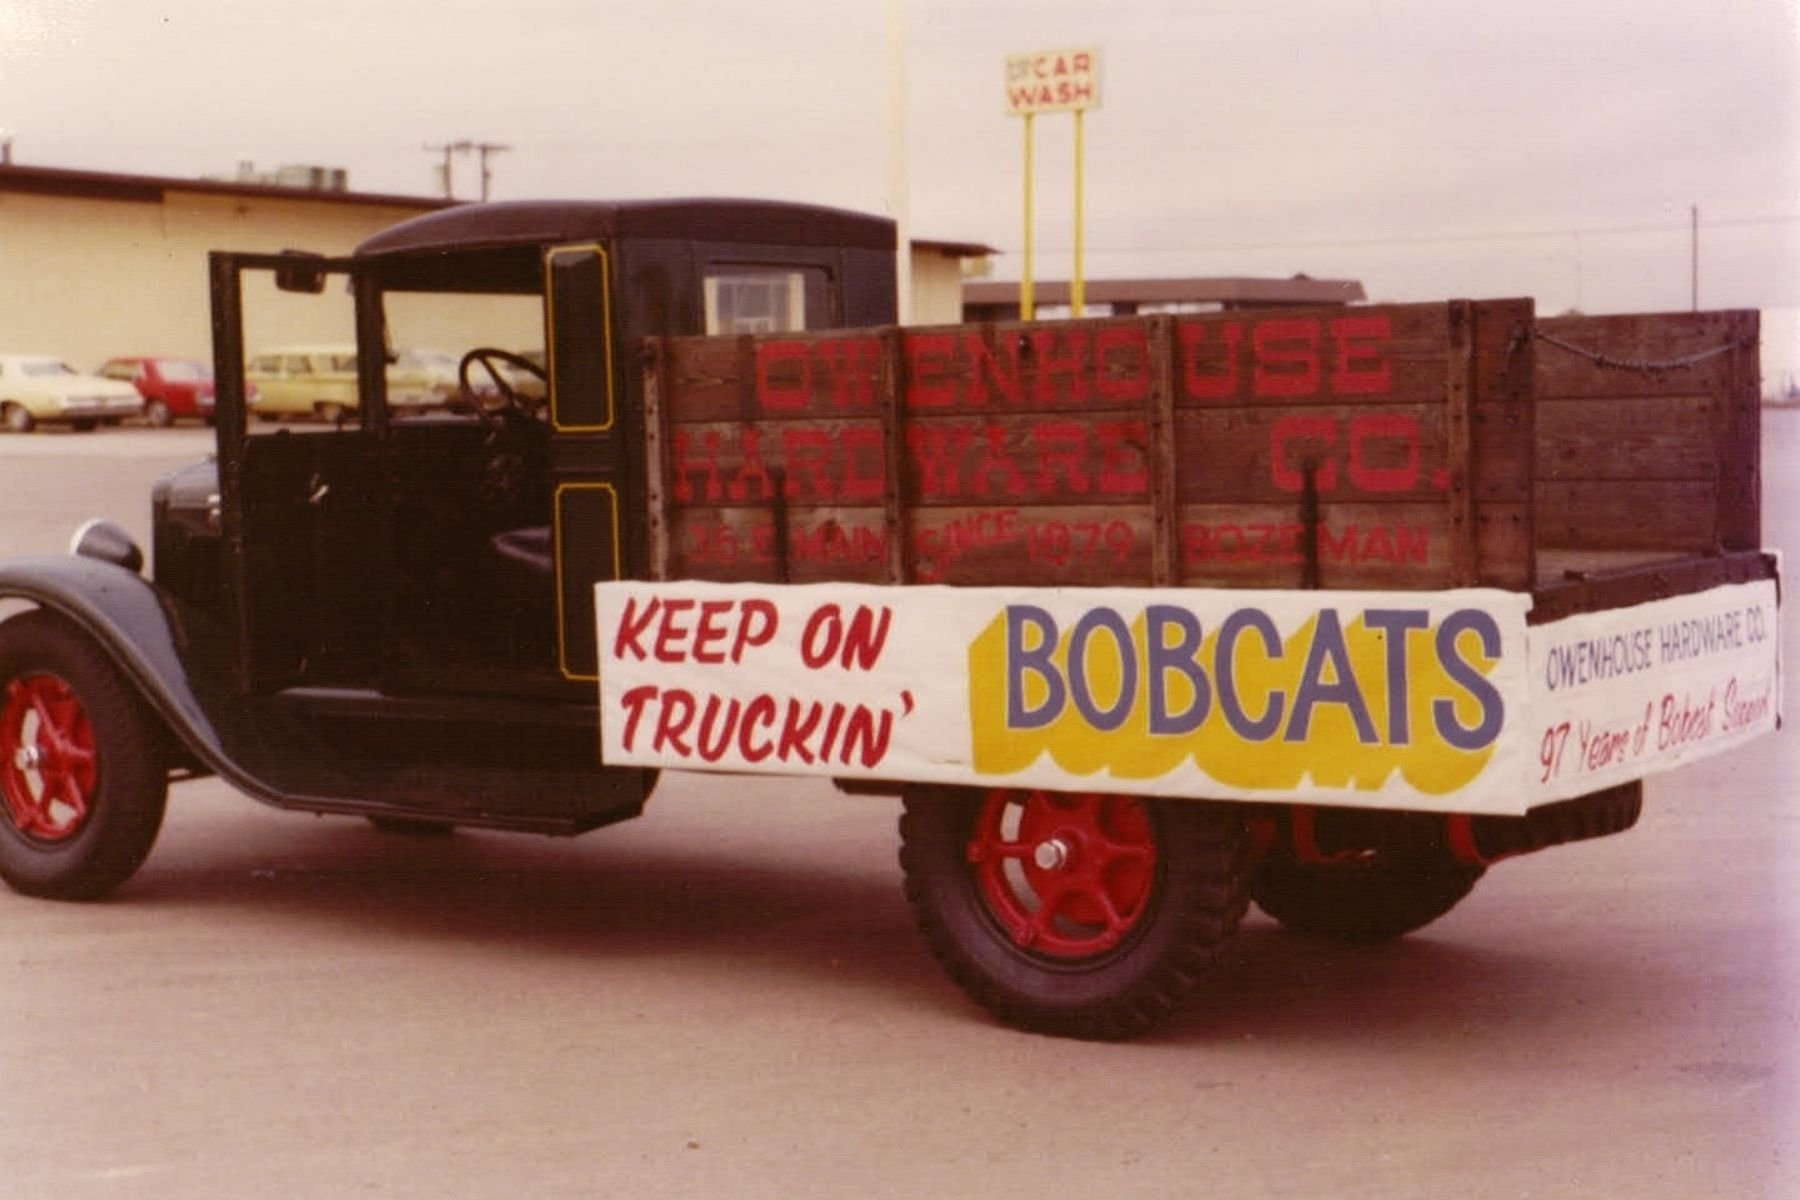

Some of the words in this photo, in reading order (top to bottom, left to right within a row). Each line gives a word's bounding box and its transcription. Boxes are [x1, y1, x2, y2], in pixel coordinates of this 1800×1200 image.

[1008, 82, 1091, 108] WASH
[1033, 51, 1089, 78] CAR
[757, 316, 1391, 408] OWENHOUSE
[674, 421, 1148, 502] HARDWARE
[1270, 414, 1451, 491] CO.
[793, 521, 886, 564] MAIN
[915, 508, 1019, 583] SINCE
[1027, 520, 1134, 566] 1879
[1182, 522, 1430, 566] BOZEMAN
[614, 596, 779, 666] KEEP
[800, 603, 892, 671] ON
[1546, 628, 1653, 691] OWENHOUSE
[1660, 611, 1742, 663] HARDWARE
[1005, 604, 1505, 751] BOBCATS
[621, 685, 914, 768] TRUCKIN'
[1540, 722, 1571, 784] 97
[1577, 720, 1629, 772] Years
[1633, 701, 1652, 757] of
